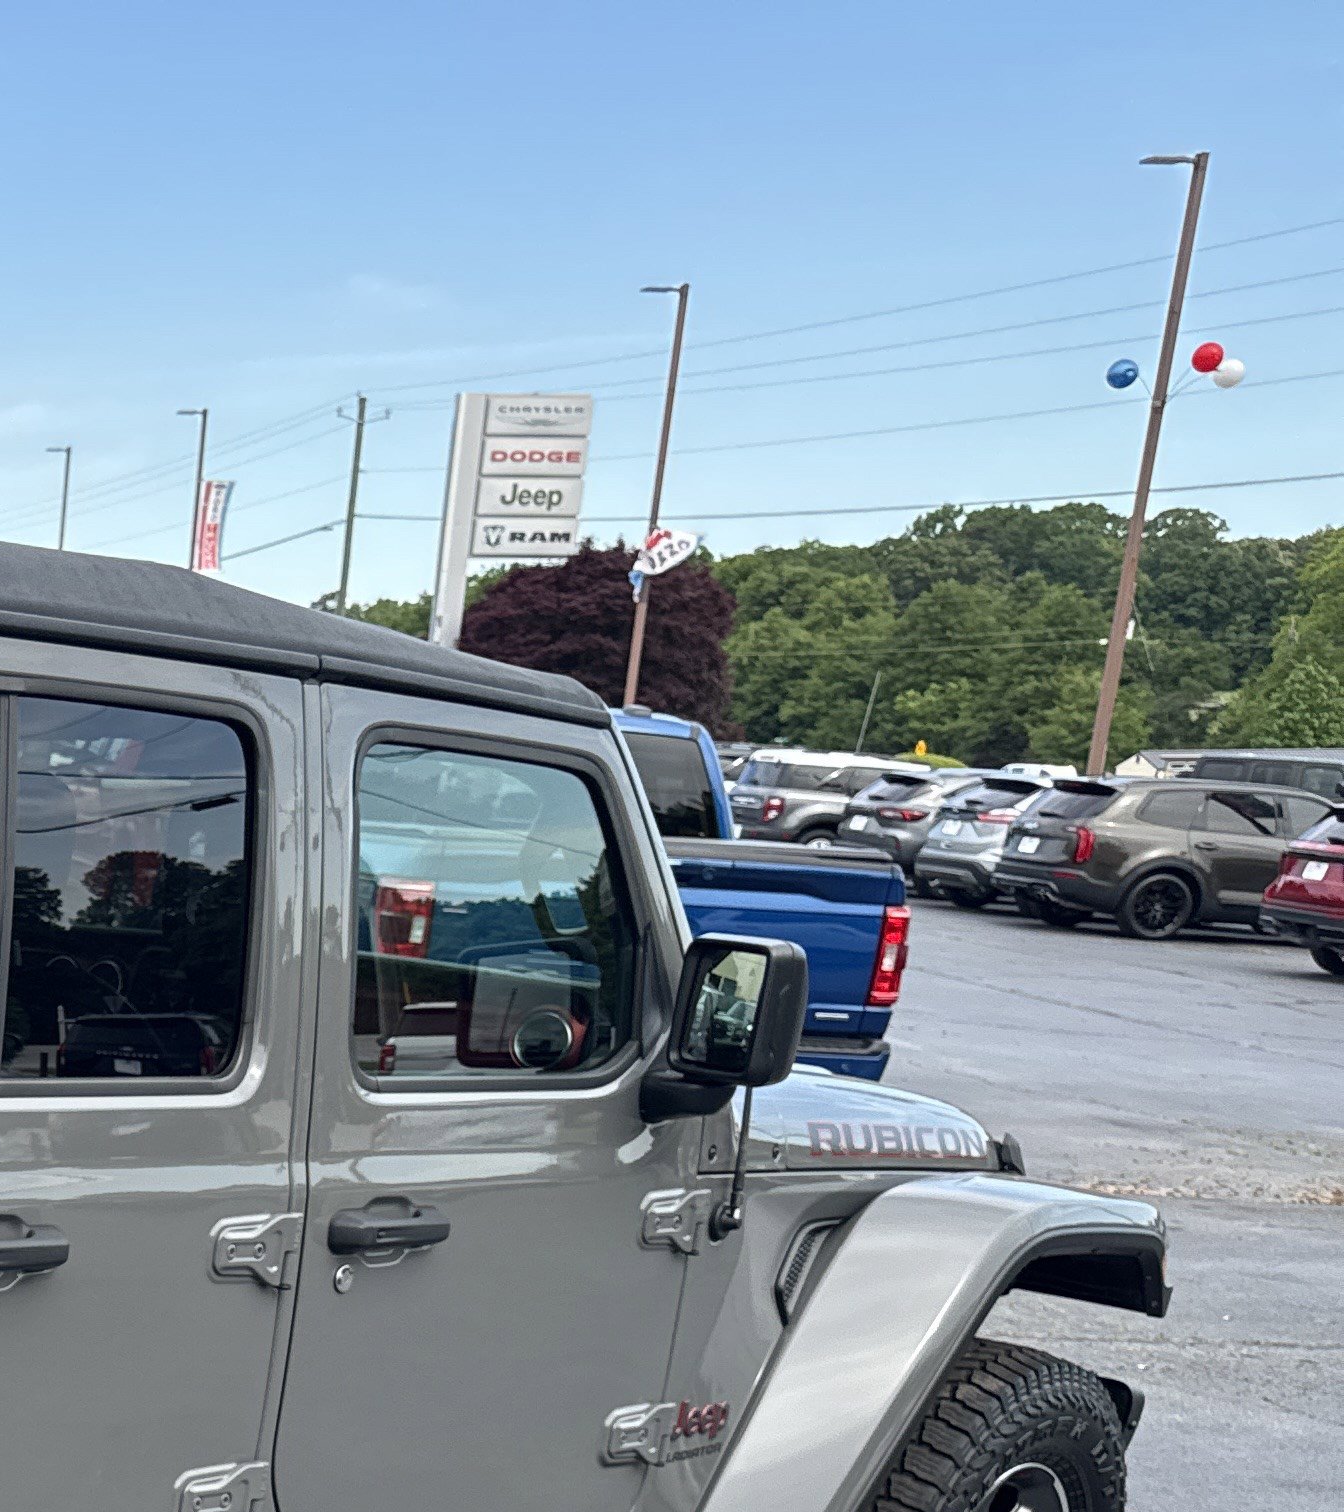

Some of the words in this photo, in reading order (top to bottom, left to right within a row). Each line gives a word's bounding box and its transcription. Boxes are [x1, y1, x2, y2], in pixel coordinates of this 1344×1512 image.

[497, 405, 585, 414] CHRYSLER
[491, 450, 581, 463] DODGE
[499, 483, 563, 511] Jeep
[509, 531, 571, 543] RAM
[807, 1122, 988, 1160] RUBICON
[670, 1400, 729, 1442] Jeep
[666, 1442, 722, 1463] LADIATOR
